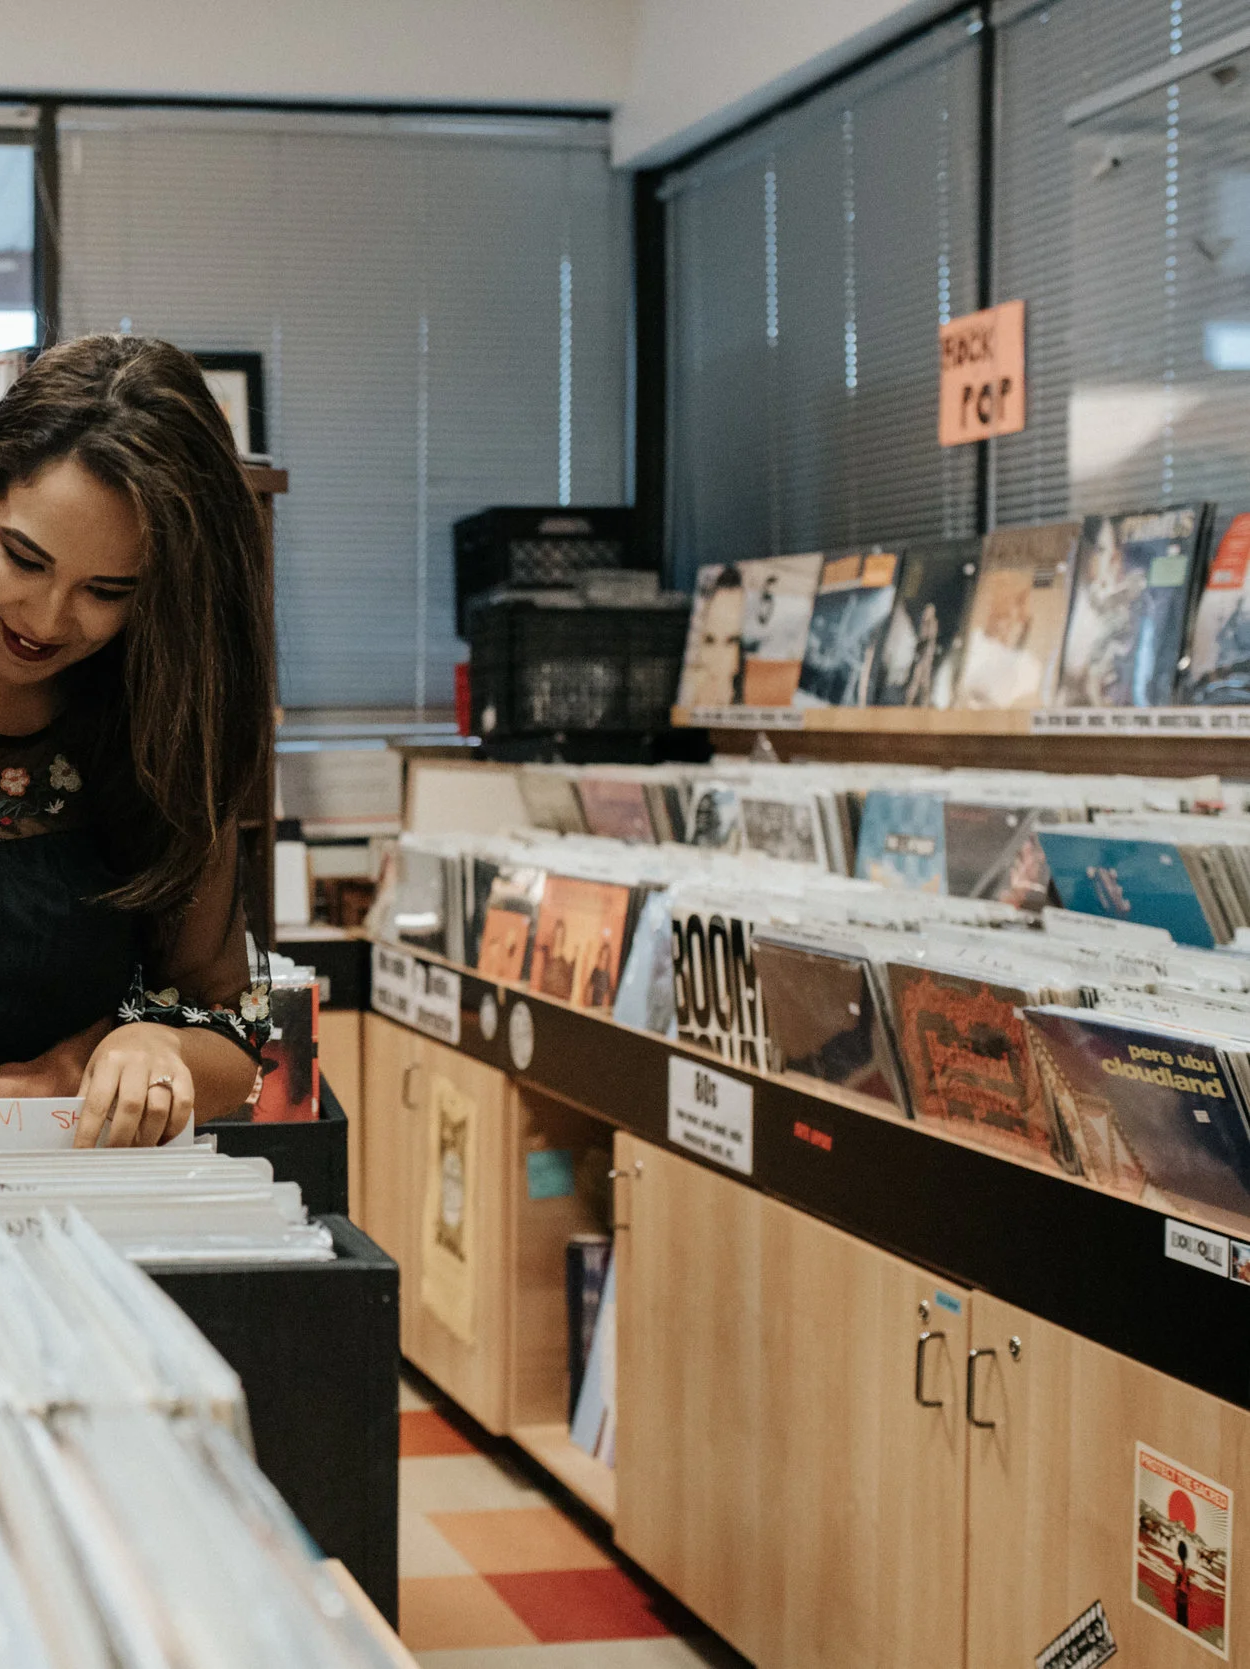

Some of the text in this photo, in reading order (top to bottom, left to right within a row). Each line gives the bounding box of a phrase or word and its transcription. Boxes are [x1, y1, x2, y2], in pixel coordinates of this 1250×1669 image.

[1127, 1044, 1218, 1074] pere ubu
[1101, 1056, 1227, 1099] cloudland
